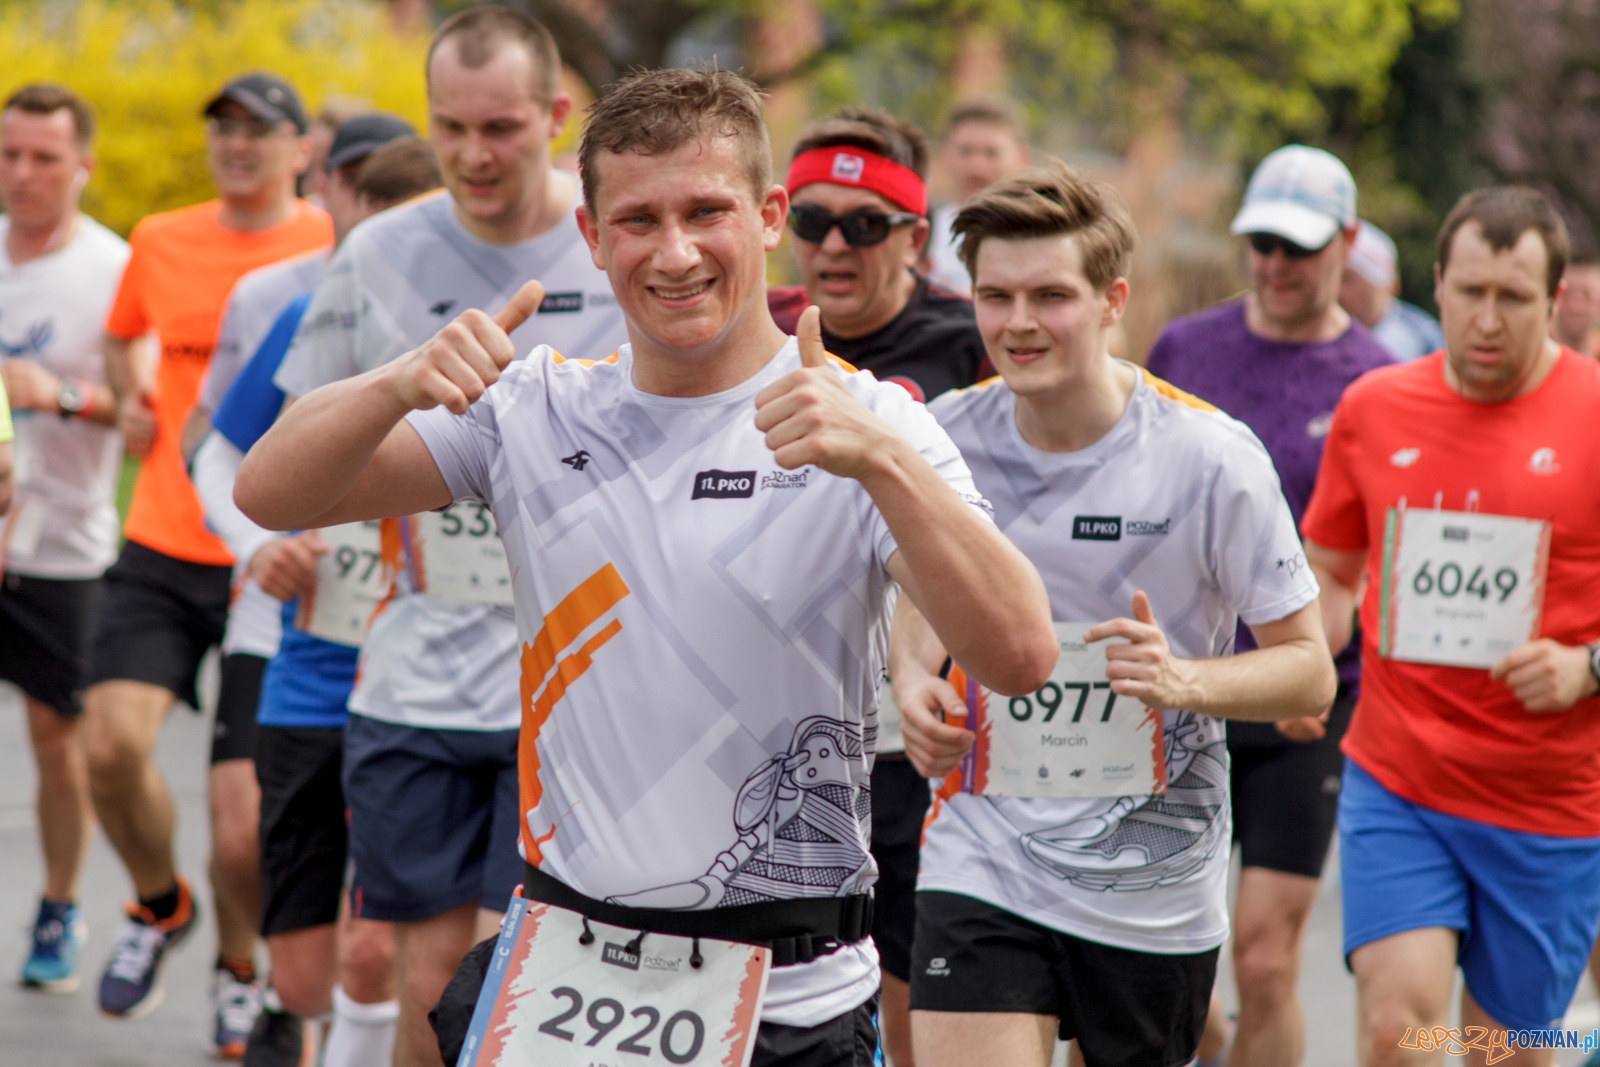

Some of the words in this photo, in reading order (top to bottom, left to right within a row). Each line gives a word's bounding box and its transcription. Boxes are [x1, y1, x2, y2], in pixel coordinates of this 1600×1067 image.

[718, 477, 751, 491] PKO
[441, 503, 500, 537] 53
[1093, 521, 1118, 535] PKO
[1413, 559, 1518, 604] 6049
[1041, 734, 1088, 747] Marcin
[538, 985, 705, 1065] 2920
